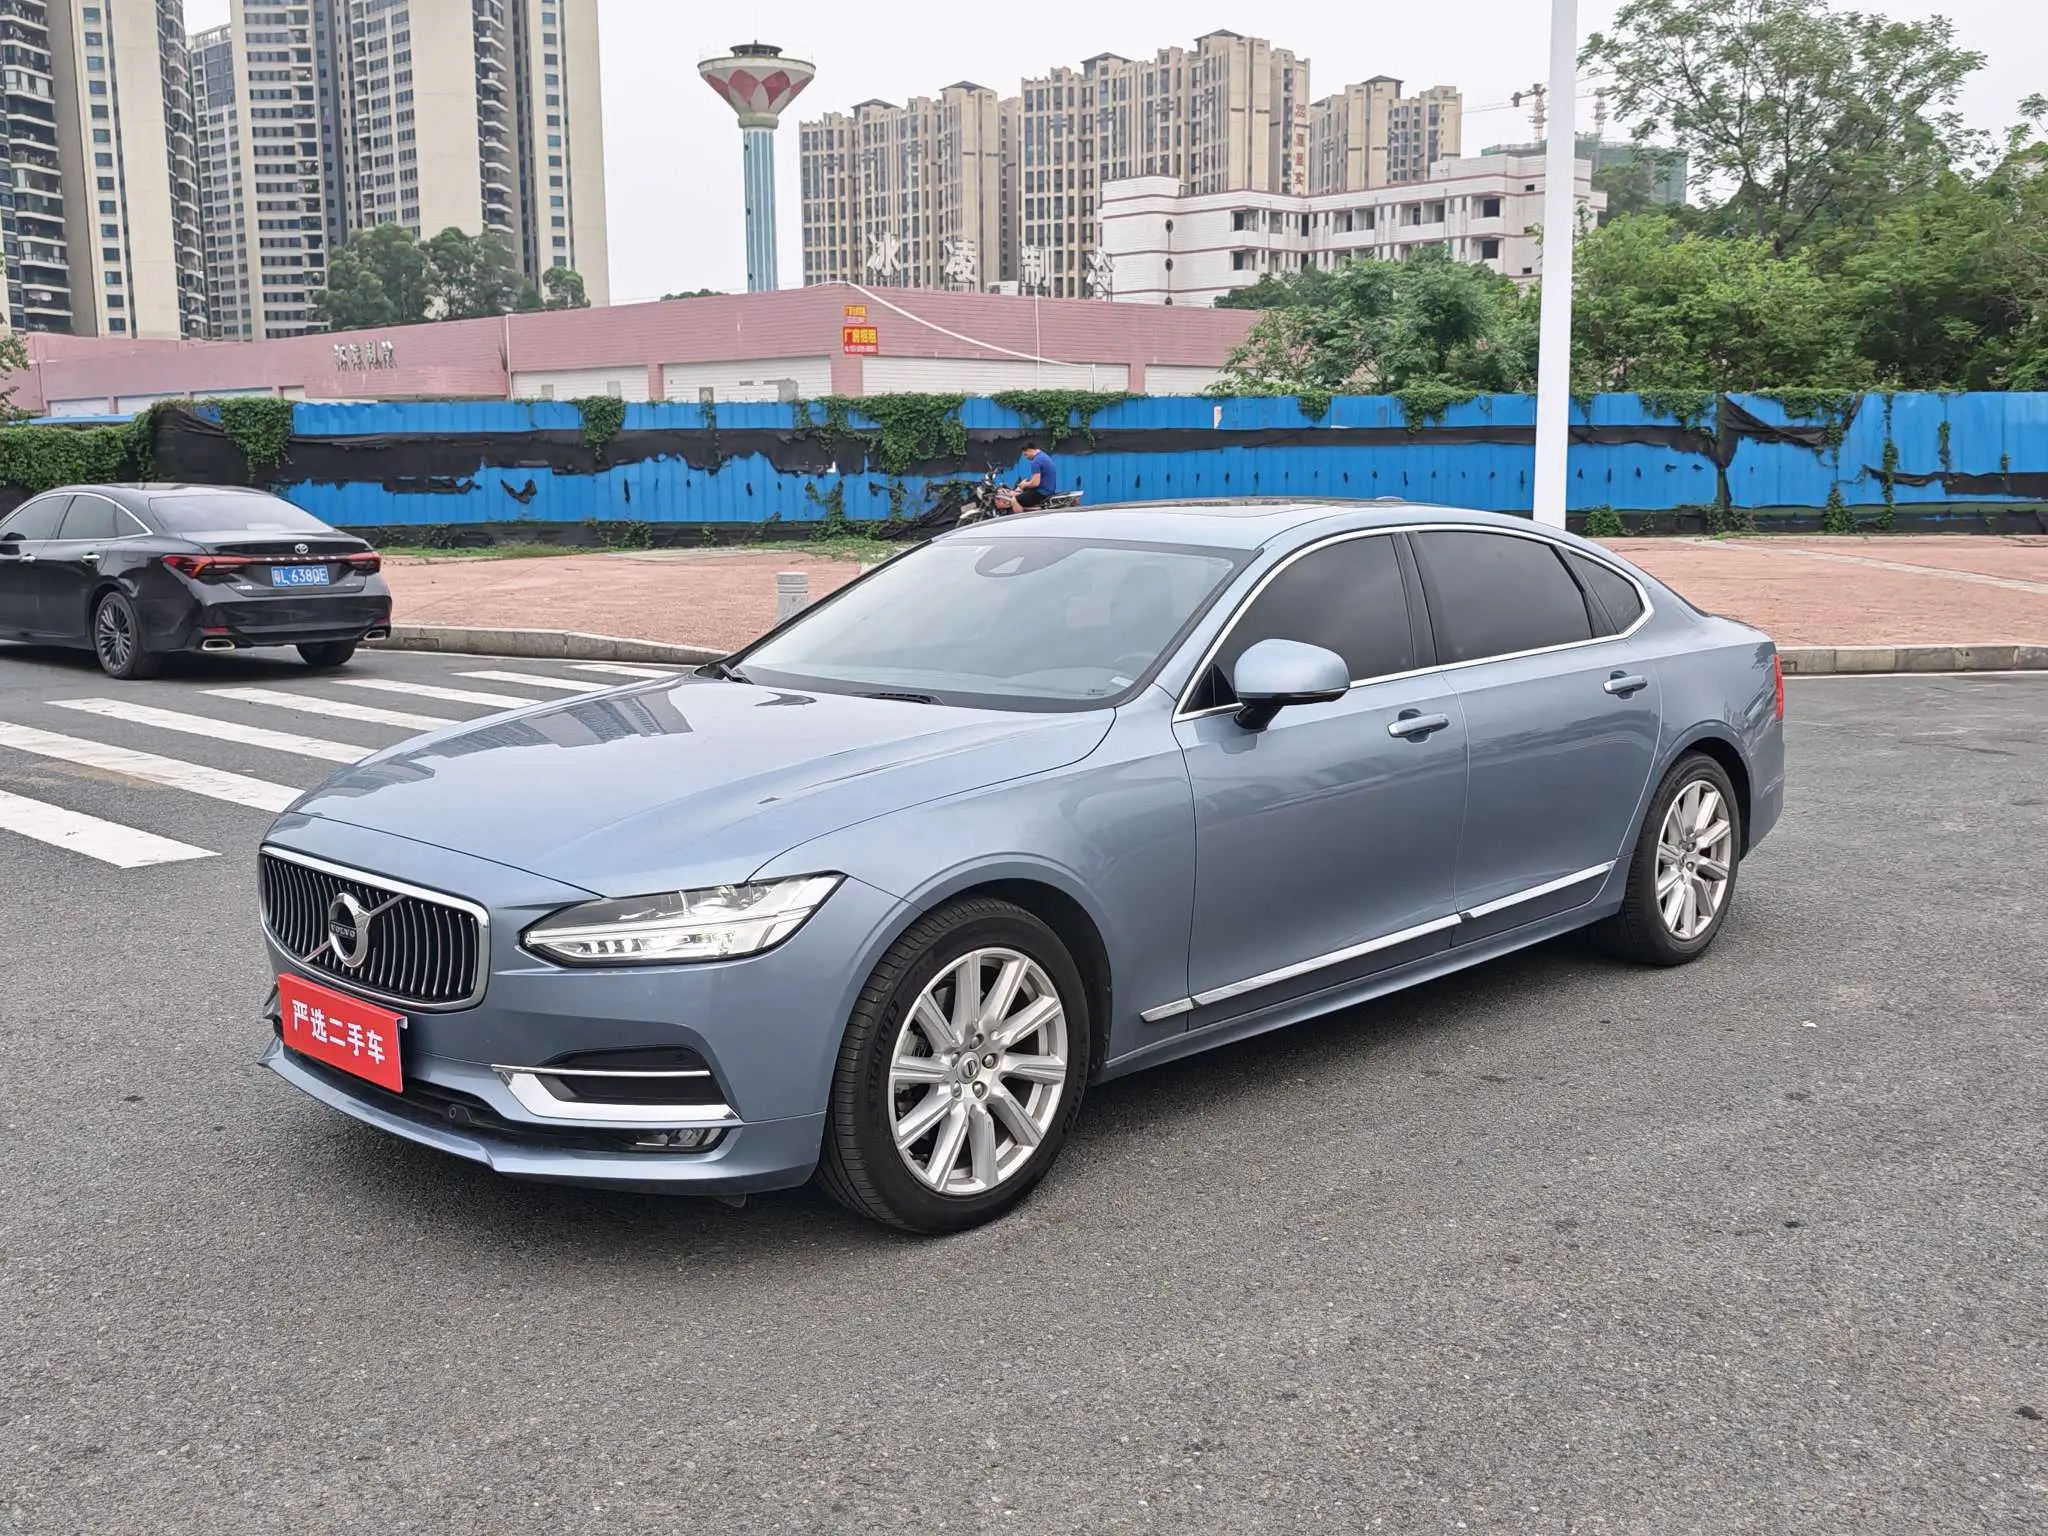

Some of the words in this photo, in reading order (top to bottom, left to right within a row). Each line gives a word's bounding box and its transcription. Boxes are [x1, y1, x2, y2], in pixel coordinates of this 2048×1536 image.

[330, 923, 356, 937] VOLVO
[292, 999, 385, 1065] 严选二手车
